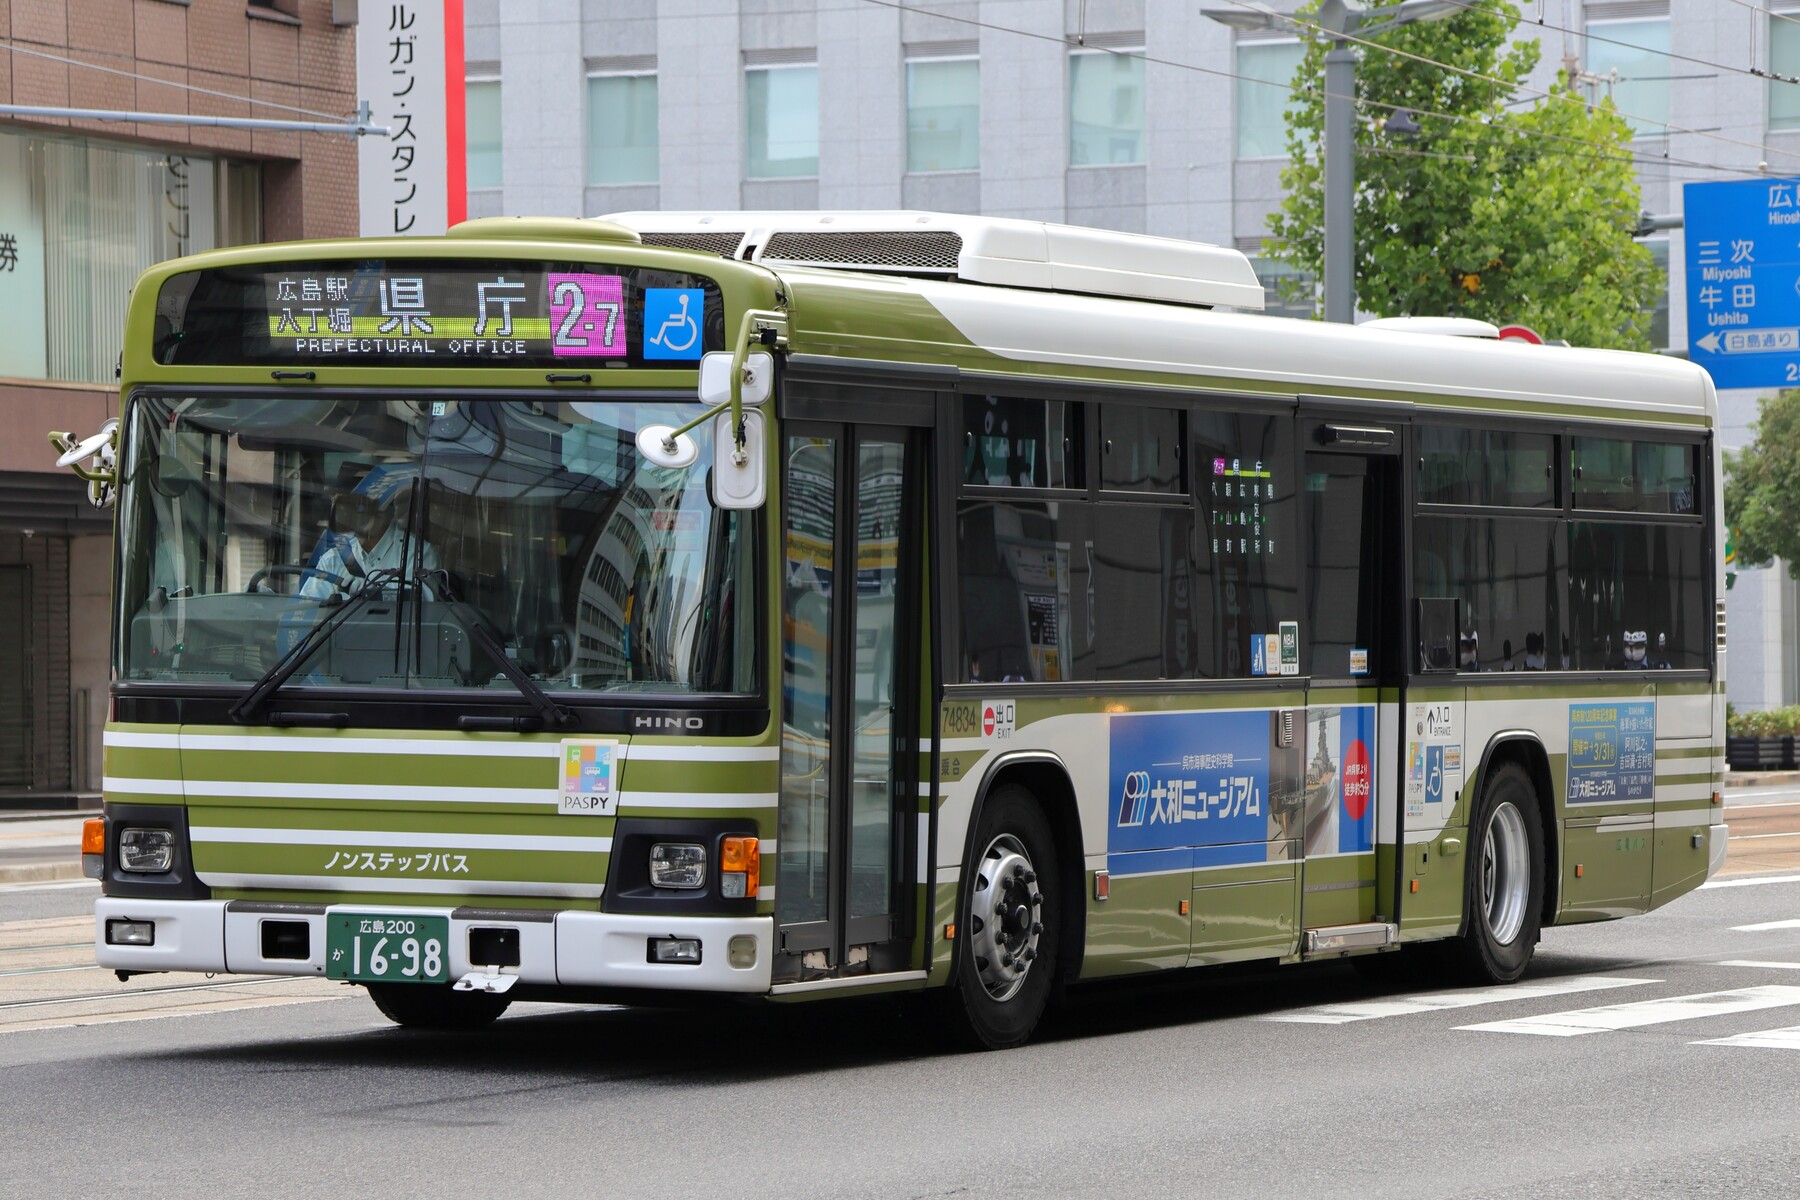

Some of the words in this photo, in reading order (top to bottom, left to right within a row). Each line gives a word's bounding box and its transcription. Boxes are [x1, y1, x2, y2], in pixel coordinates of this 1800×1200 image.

[389, 5, 416, 233] ルガン・スタンレ
[1768, 184, 1800, 208] 広
[0, 233, 18, 272] 券
[1698, 239, 1754, 264] 三次
[1703, 266, 1751, 283] Miyoshi
[277, 277, 348, 302] 広島駅
[1699, 284, 1755, 310] 牛田
[378, 276, 526, 336] 県庁
[553, 281, 620, 348] 2-7
[276, 307, 353, 333] 八丁堀
[1708, 312, 1749, 326] Ushita
[296, 339, 435, 354] PREFECTURAL
[449, 339, 526, 354] OFFICE
[1731, 333, 1792, 349] 白島通り
[1785, 363, 1800, 381] 2
[635, 716, 703, 729] HINO
[943, 706, 976, 733] 74834
[996, 704, 1013, 723] 出口
[1436, 706, 1449, 723] 入口
[998, 728, 1011, 739] EXIT
[1434, 726, 1451, 736] ENTRANCE
[941, 757, 960, 776] 乗合
[1182, 753, 1233, 771] 呉市海事歴史科学館
[1344, 778, 1370, 797] 徒歩約5分
[1409, 783, 1423, 793] PASPY
[1579, 780, 1616, 797] 大和ミュージアム
[564, 796, 609, 809] PASPY
[1150, 776, 1260, 825] 大和ミュージアム
[324, 851, 469, 873] ノンステップバス
[360, 919, 415, 934] 広島200
[332, 949, 344, 961] か
[353, 936, 441, 977] 16-98
